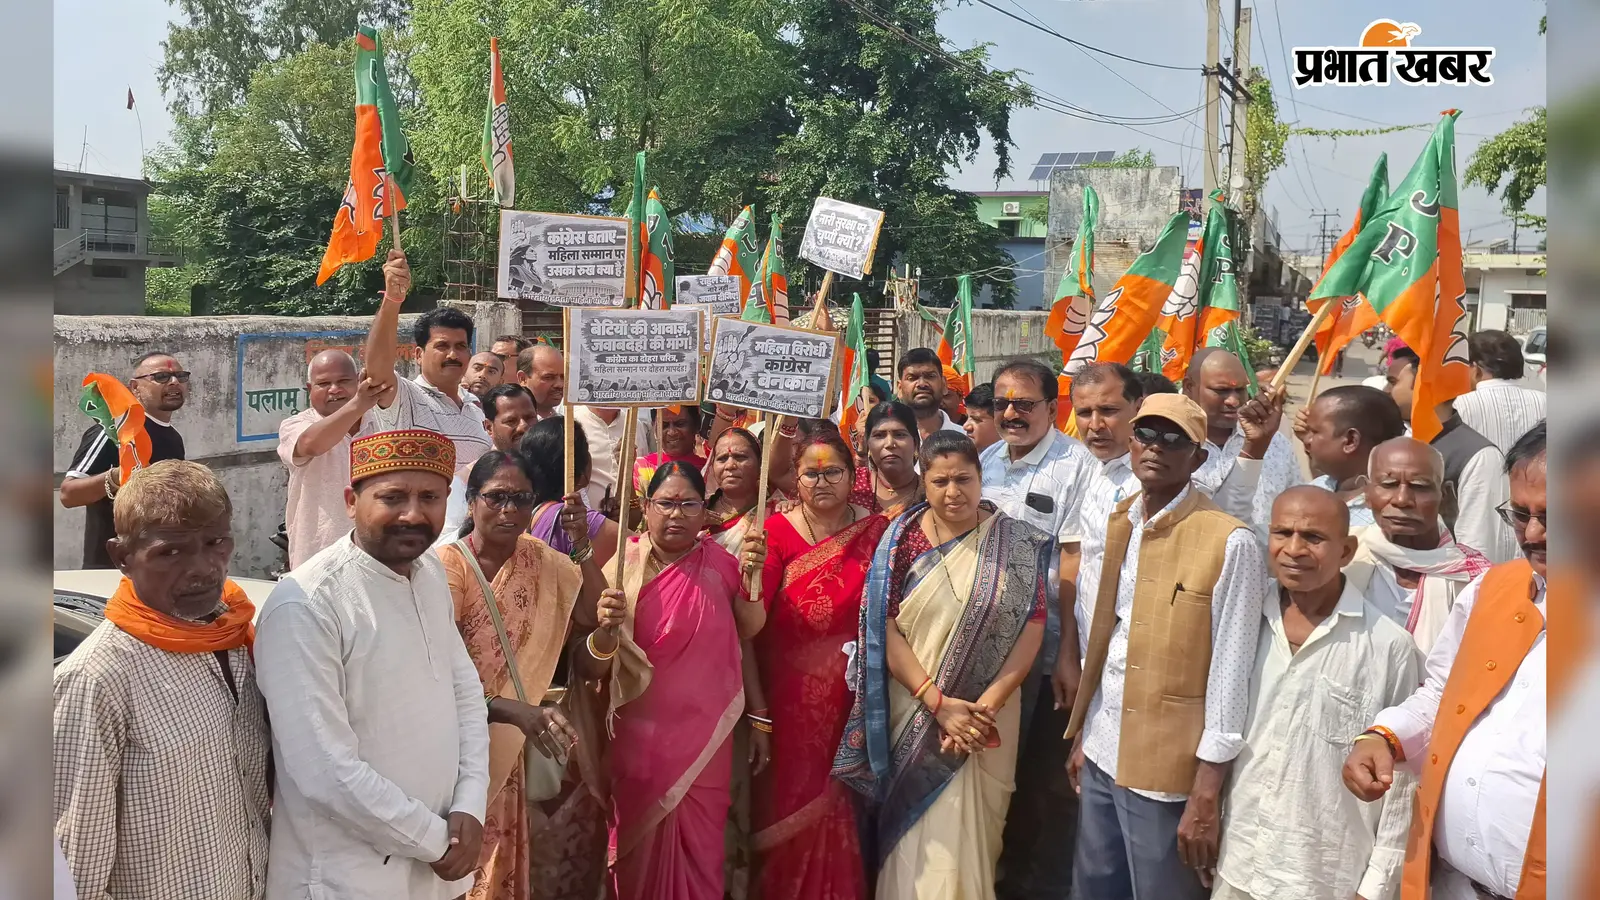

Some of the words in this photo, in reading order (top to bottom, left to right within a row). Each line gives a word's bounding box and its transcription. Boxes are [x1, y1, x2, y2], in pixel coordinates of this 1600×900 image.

[819, 212, 836, 226] नारी
[836, 216, 858, 231] सुरक्षा
[857, 223, 868, 234] पर
[547, 228, 586, 245] कांग्रेस
[816, 228, 838, 246] चुप्पी
[838, 232, 862, 250] क्यों?
[548, 247, 580, 262] महिला
[581, 250, 613, 260] सम्मान
[547, 266, 576, 276] उसका
[577, 265, 596, 276] रुख
[596, 264, 614, 276] क्या
[615, 261, 625, 276] है
[590, 318, 628, 336] बेटियों
[628, 320, 648, 336] की
[591, 335, 648, 352] जवाबदेही
[649, 336, 665, 350] की
[666, 336, 692, 350] मांग!
[754, 339, 790, 355] महिला
[792, 340, 827, 357] विरोधी
[605, 354, 627, 363] कांग्रेस
[640, 354, 658, 363] दोहरा
[764, 356, 812, 373] कांग्रेस
[594, 365, 615, 374] महिला
[648, 365, 664, 373] दोहरा
[758, 370, 820, 391] बेनकाब
[245, 388, 300, 415] पलामू
[593, 389, 620, 398] भारतीय
